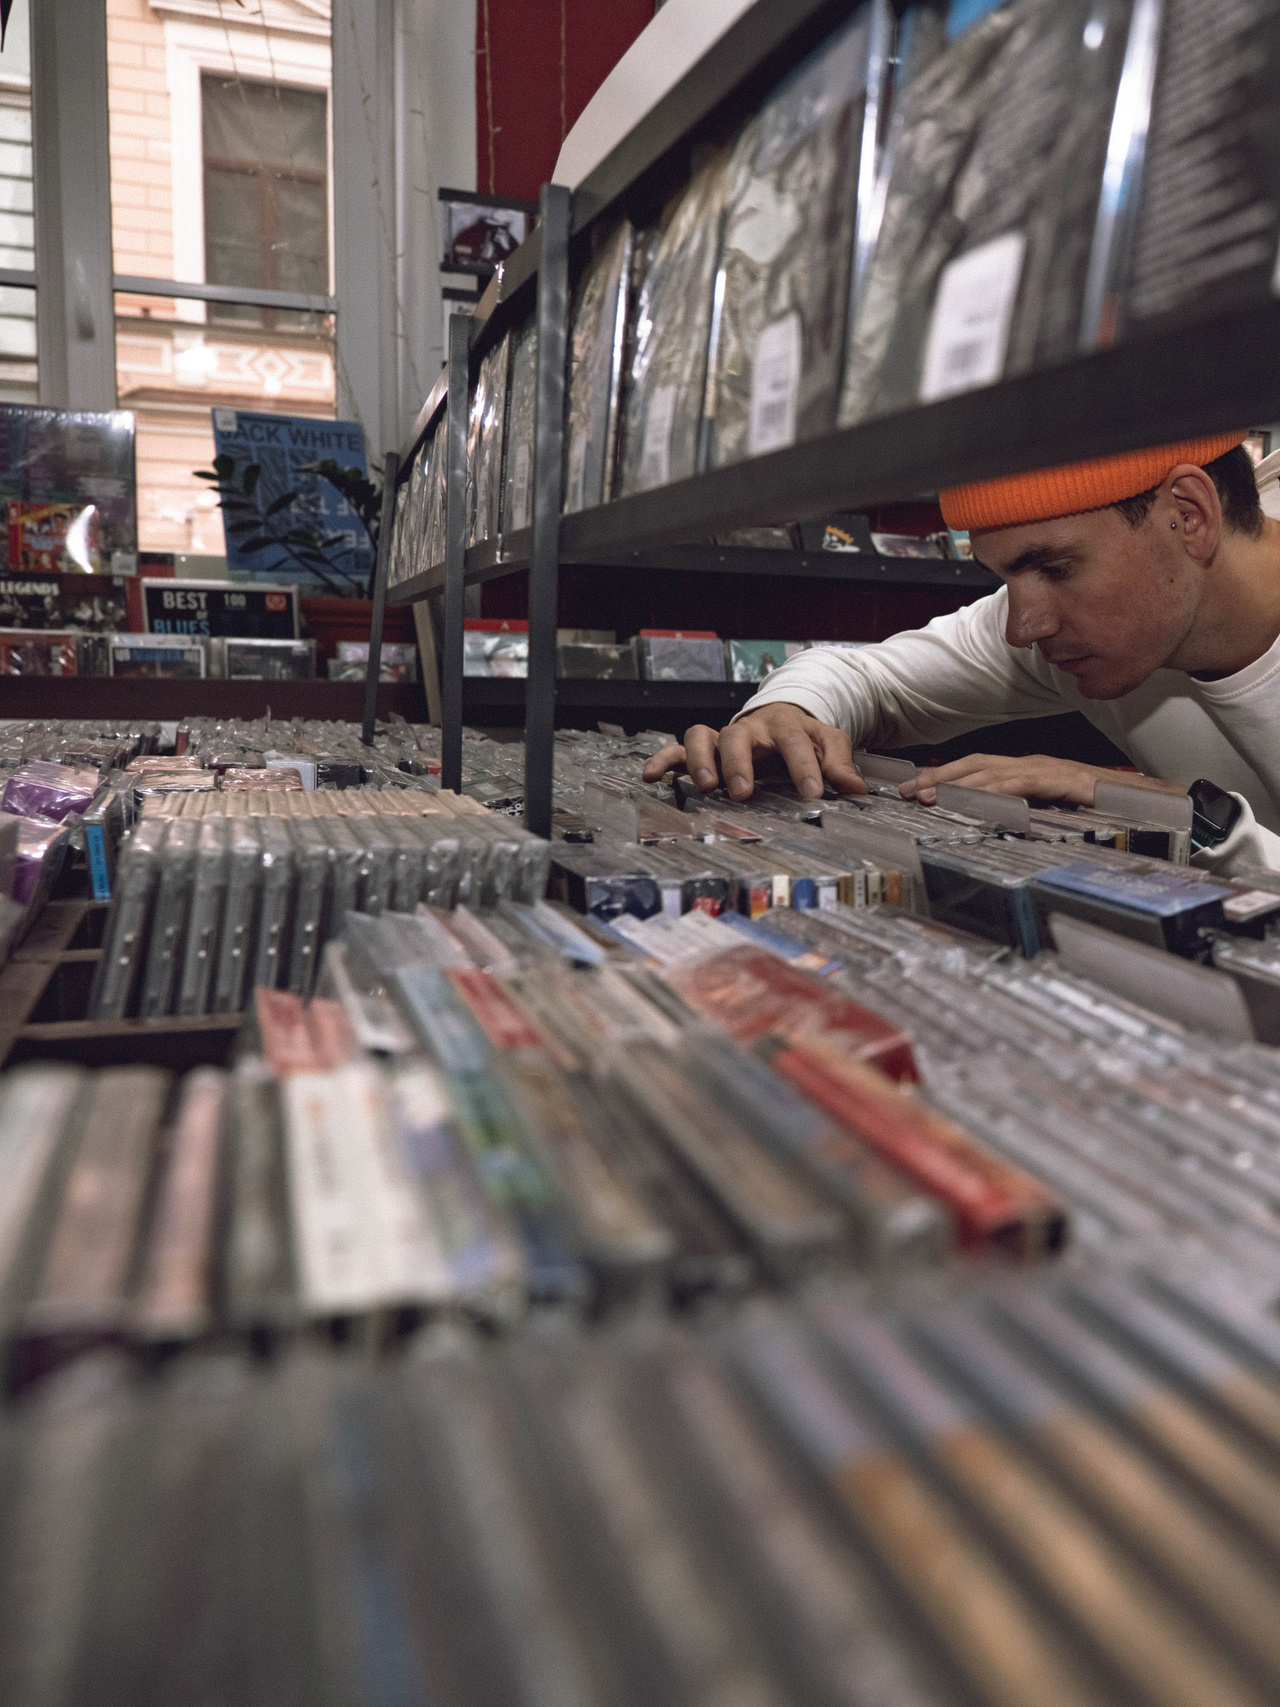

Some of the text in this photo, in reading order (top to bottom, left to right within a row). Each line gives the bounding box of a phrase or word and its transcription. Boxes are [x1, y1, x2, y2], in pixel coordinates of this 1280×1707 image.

[287, 428, 362, 451] WHITE
[162, 590, 208, 610] BEST
[224, 593, 246, 607] 100
[153, 618, 211, 637] BLUES
